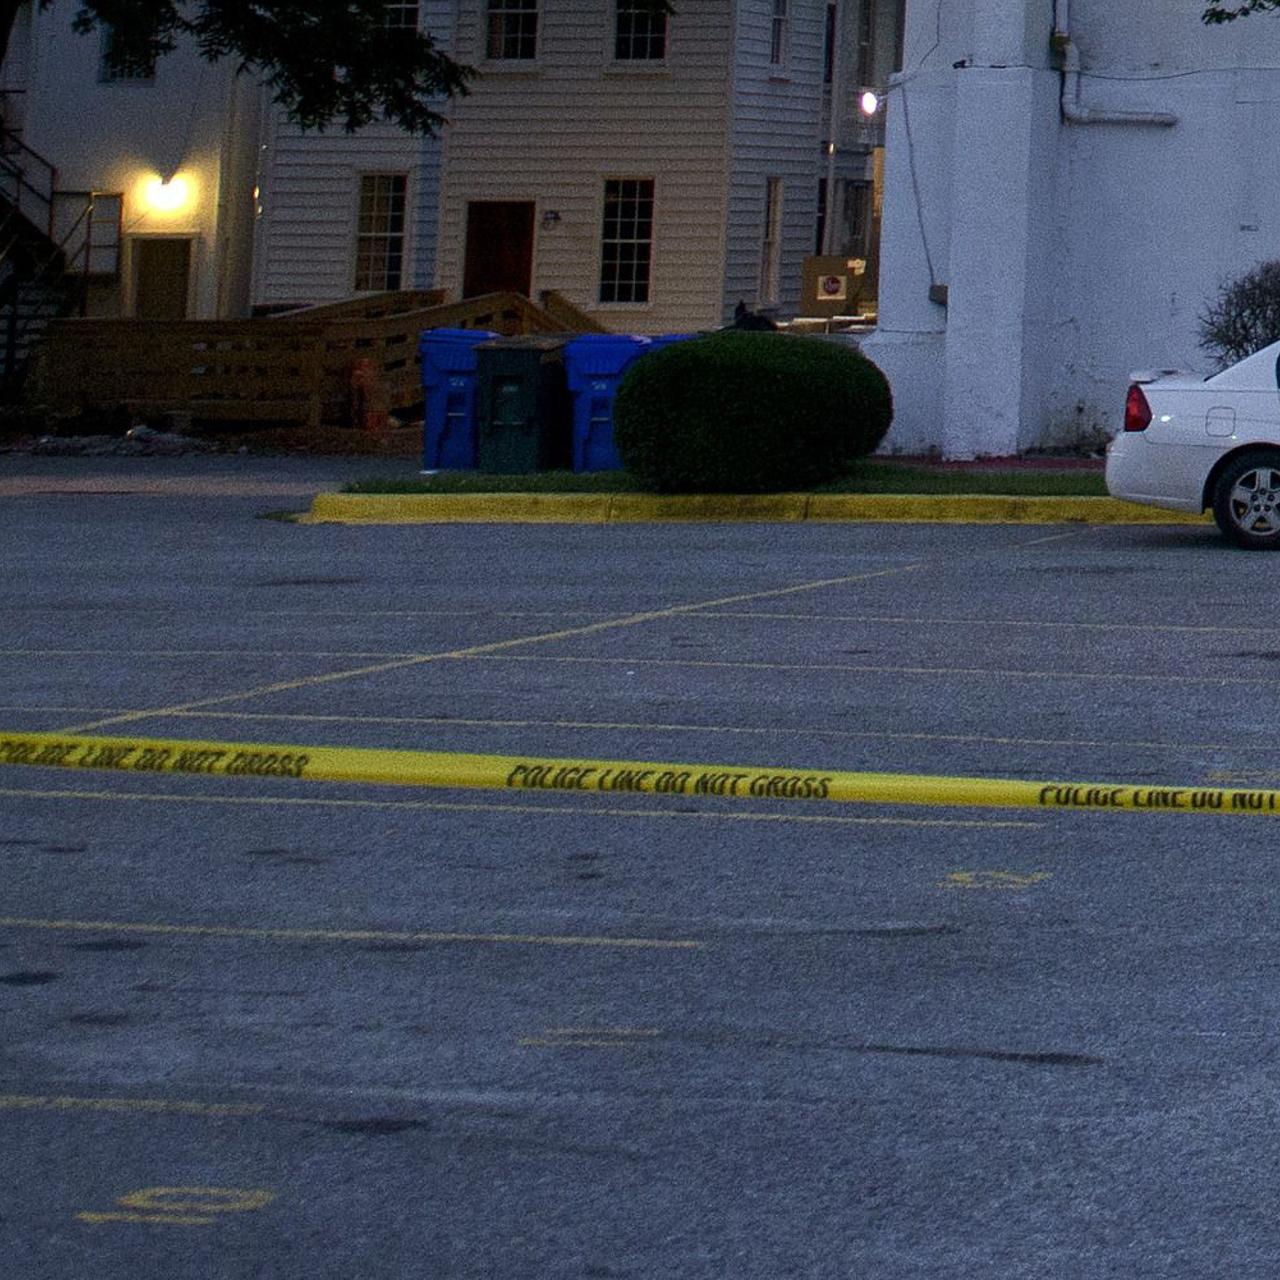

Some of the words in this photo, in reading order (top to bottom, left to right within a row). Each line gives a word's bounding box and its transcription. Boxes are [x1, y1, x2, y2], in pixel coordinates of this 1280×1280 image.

[80, 744, 136, 768] LINE
[135, 747, 171, 771] DO
[173, 750, 226, 774] NOT
[227, 751, 309, 777] CROSS
[507, 764, 596, 790] POLICE
[598, 768, 656, 792] LINE
[655, 770, 691, 794] DO
[693, 772, 747, 797] NOT
[749, 775, 831, 799] CROSS
[1039, 786, 1125, 806] POLICE
[1132, 790, 1184, 808] LINE
